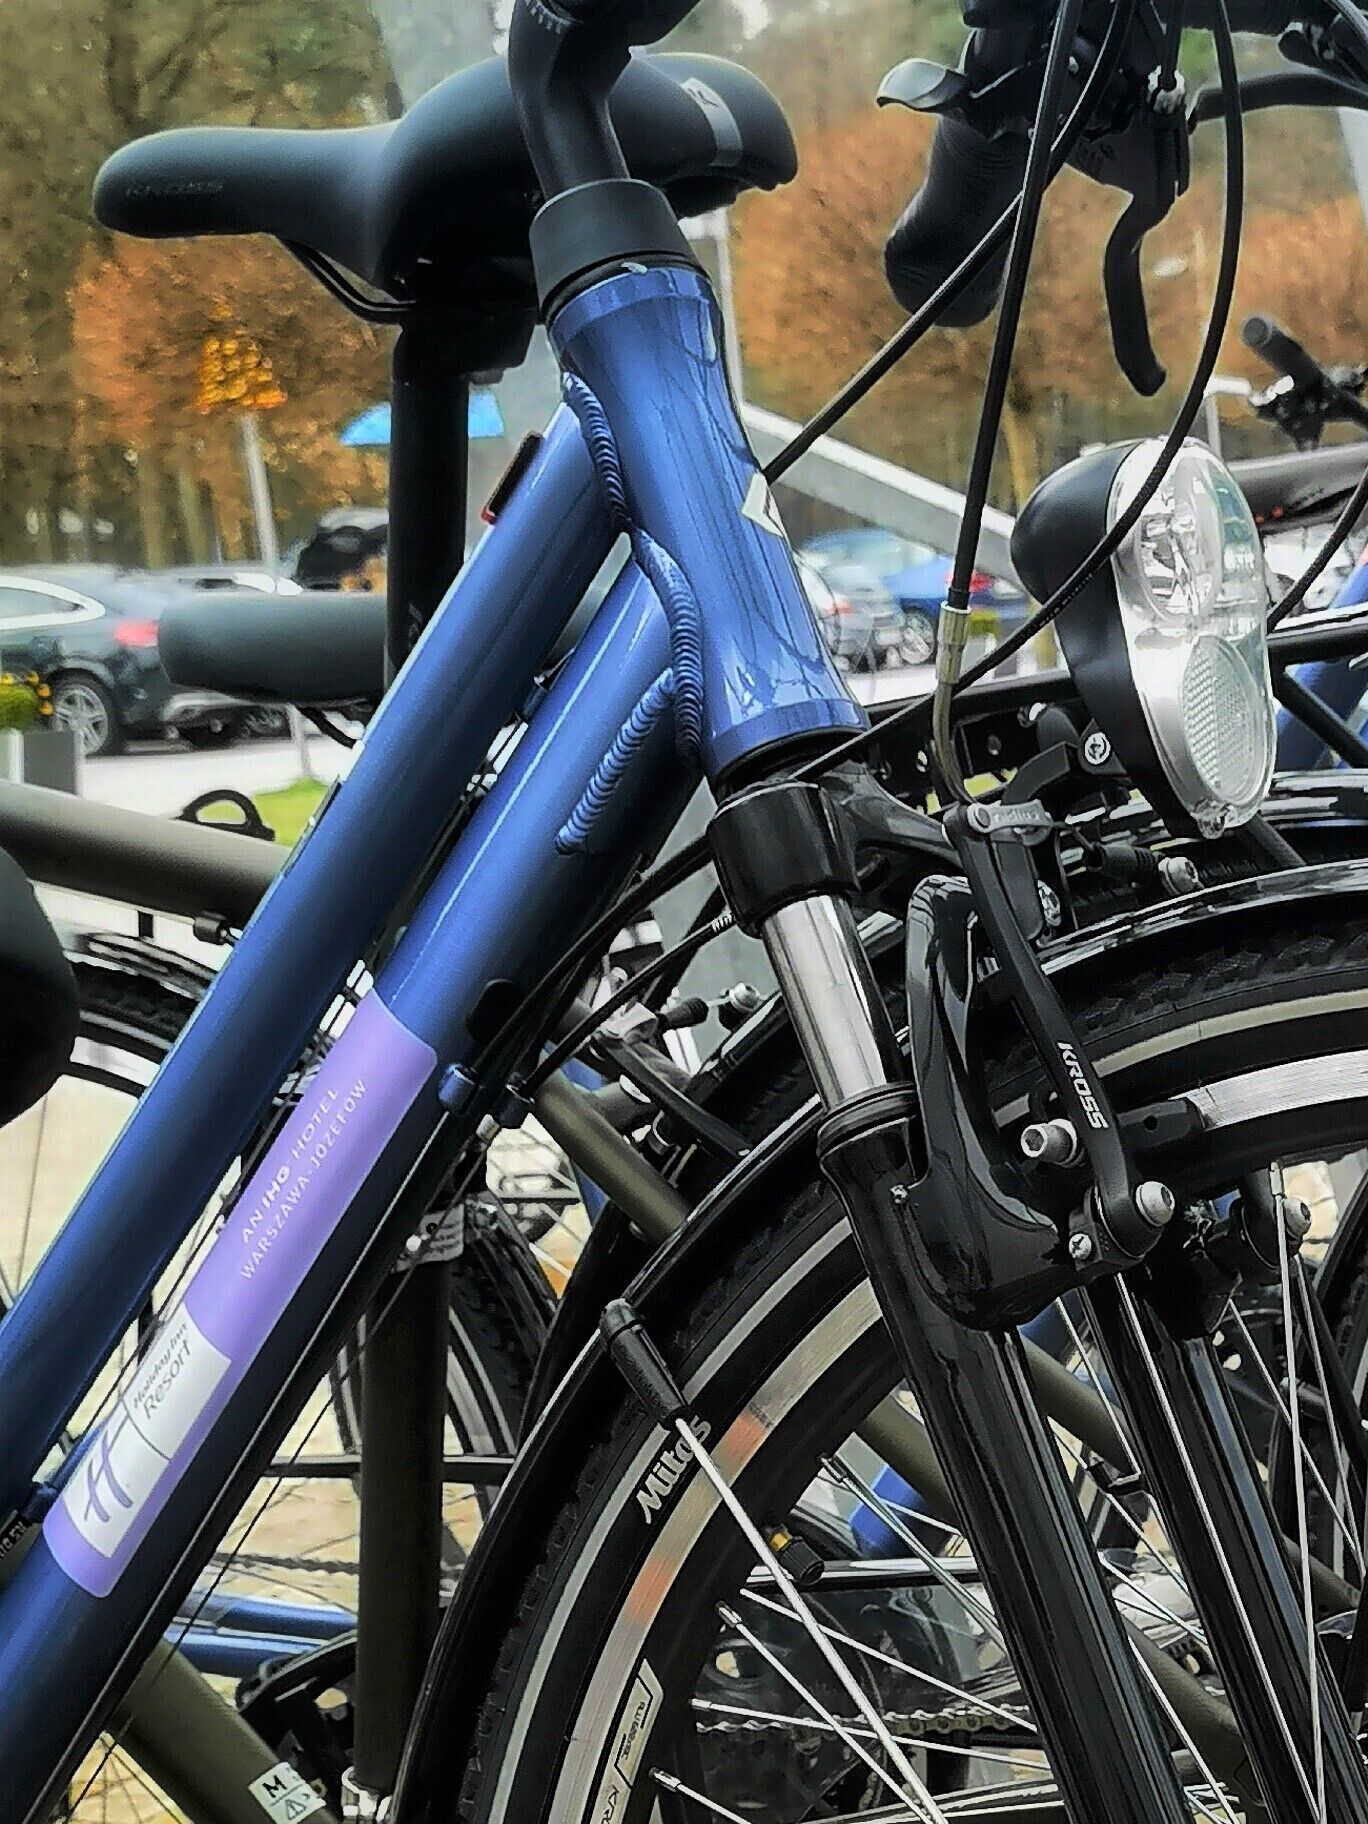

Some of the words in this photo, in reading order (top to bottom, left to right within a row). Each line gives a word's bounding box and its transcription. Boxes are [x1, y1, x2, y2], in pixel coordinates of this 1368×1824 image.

[1057, 1042, 1110, 1129] KROSS
[242, 1209, 264, 1243] AN
[262, 1164, 291, 1209] IHG
[291, 1089, 339, 1159] HOTEL
[143, 1339, 192, 1419] Resort
[636, 1415, 712, 1525] Mitas
